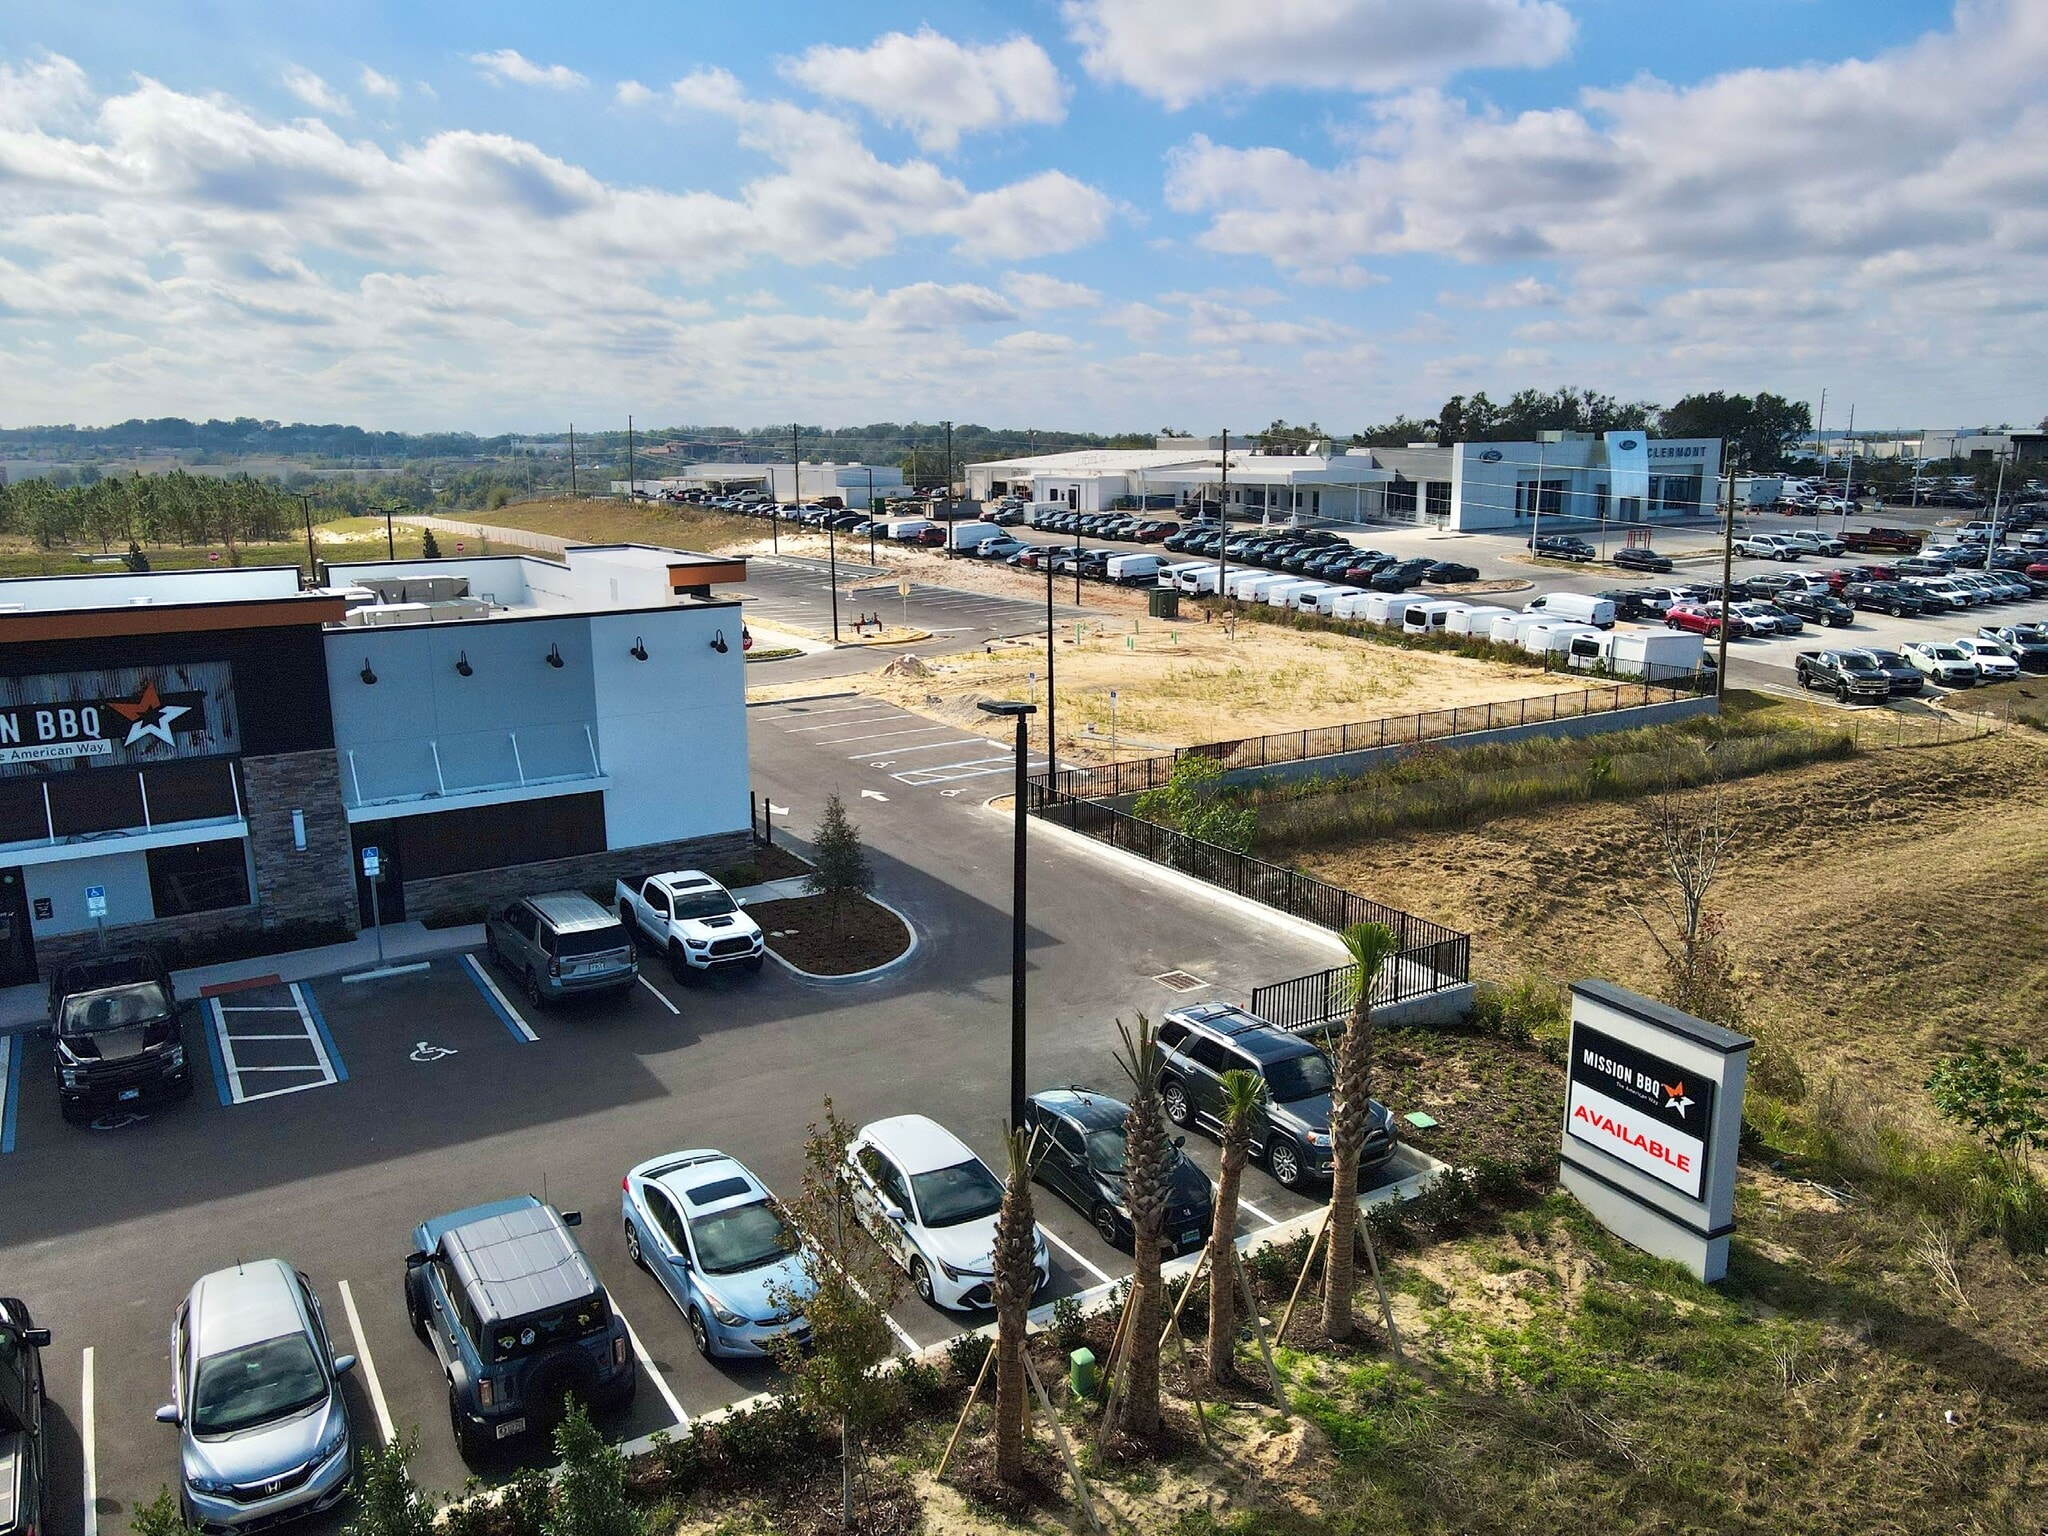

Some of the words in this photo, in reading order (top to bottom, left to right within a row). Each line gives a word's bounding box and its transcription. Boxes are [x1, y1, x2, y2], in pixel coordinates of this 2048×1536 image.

[1647, 446, 1707, 459] CLERMONT
[36, 707, 101, 740] BBQ
[11, 747, 73, 761] American
[1584, 1049, 1633, 1084] MISSION
[1636, 1072, 1660, 1099] BBQ
[1625, 1086, 1648, 1100] American
[1574, 1105, 1691, 1173] AVAILABLE
